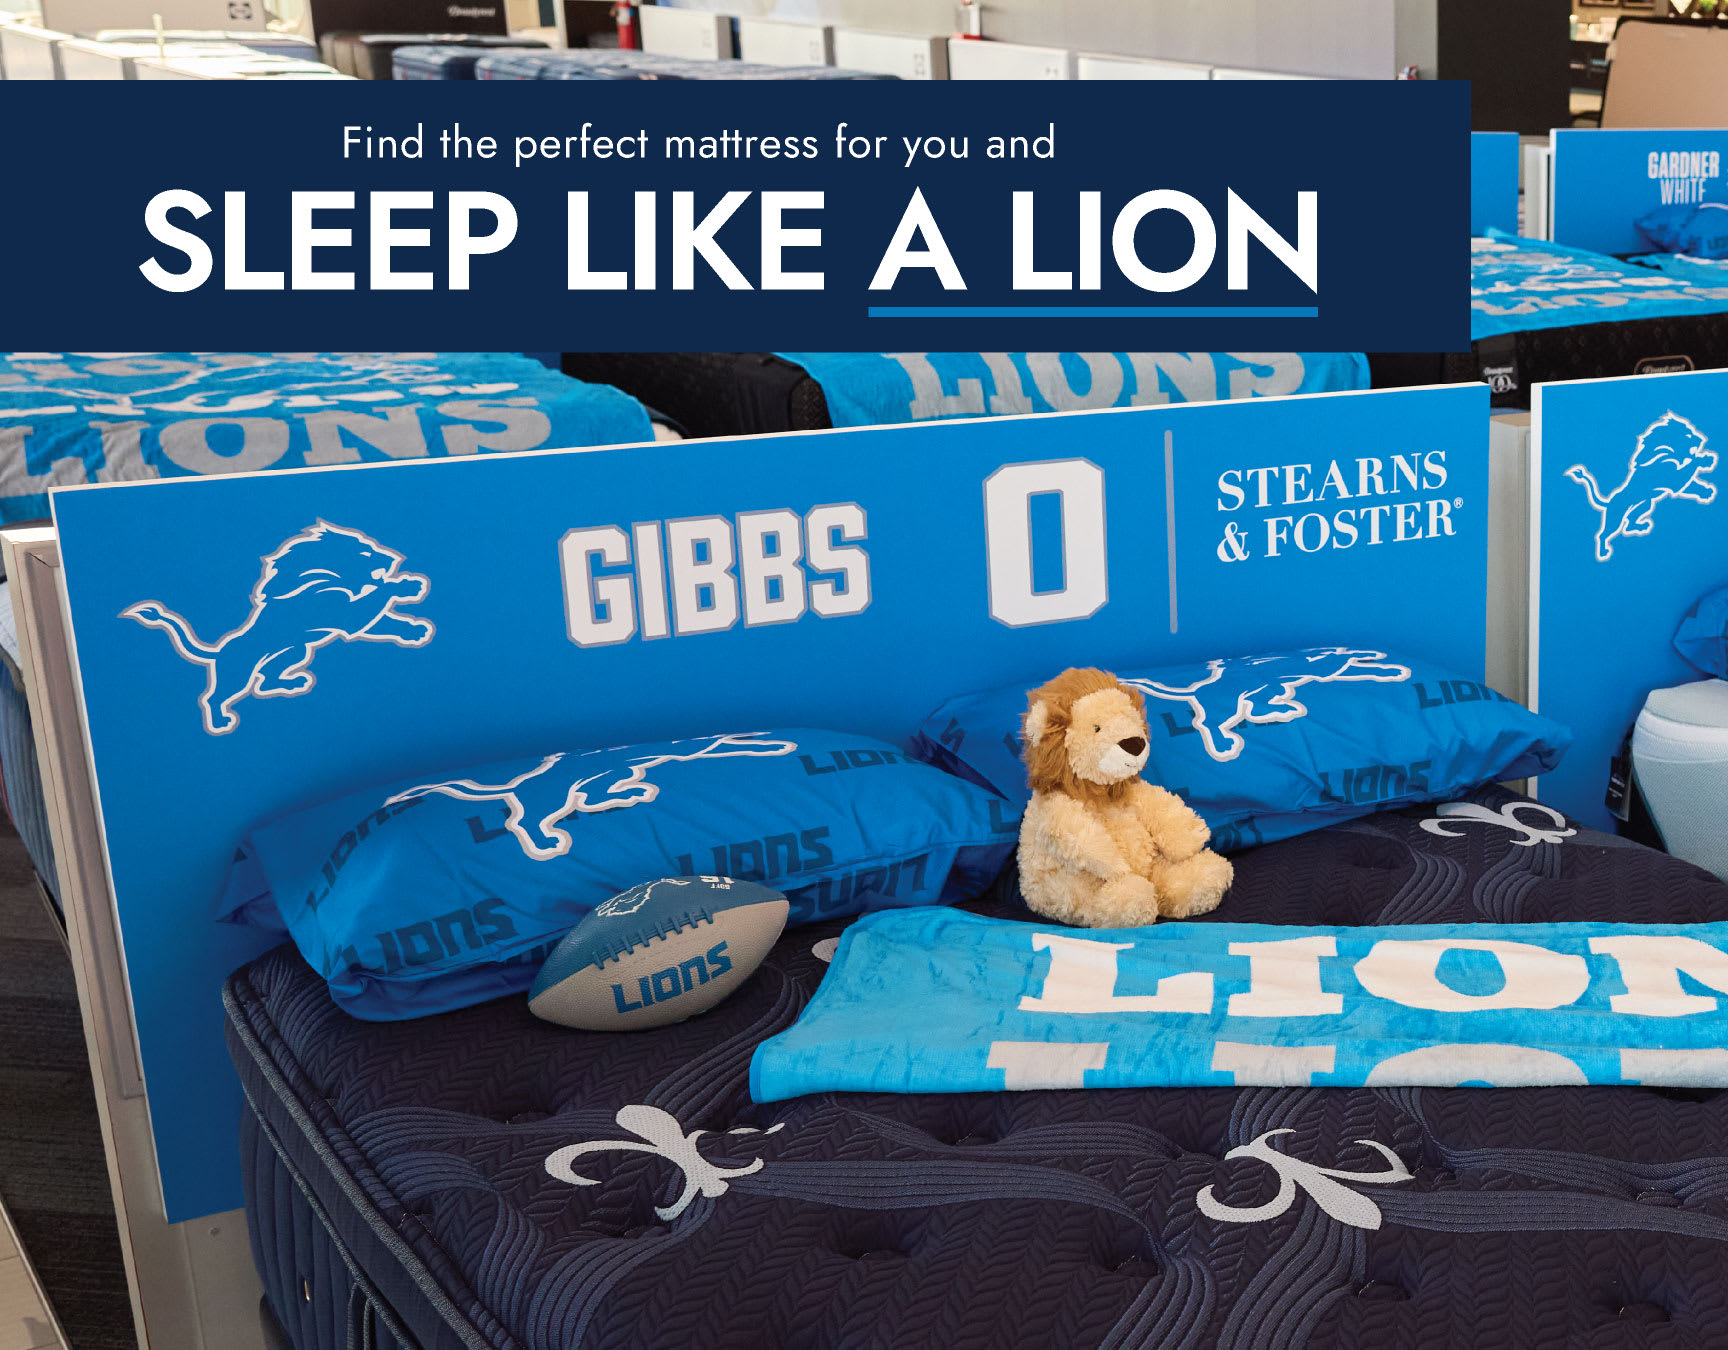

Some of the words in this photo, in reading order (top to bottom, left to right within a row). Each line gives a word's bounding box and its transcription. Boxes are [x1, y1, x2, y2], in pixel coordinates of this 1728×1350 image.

[1648, 151, 1720, 179] GARDNER
[1660, 178, 1706, 205] WHITE
[0, 397, 552, 498] LIONS
[1217, 450, 1448, 512] STEARNS
[558, 501, 872, 648] GIBBS
[983, 456, 1110, 629] 0
[1216, 521, 1250, 563] &
[1413, 679, 1512, 710] LION
[799, 748, 920, 777] LION
[1319, 760, 1433, 803] LIONS
[611, 940, 733, 1014] LIONS
